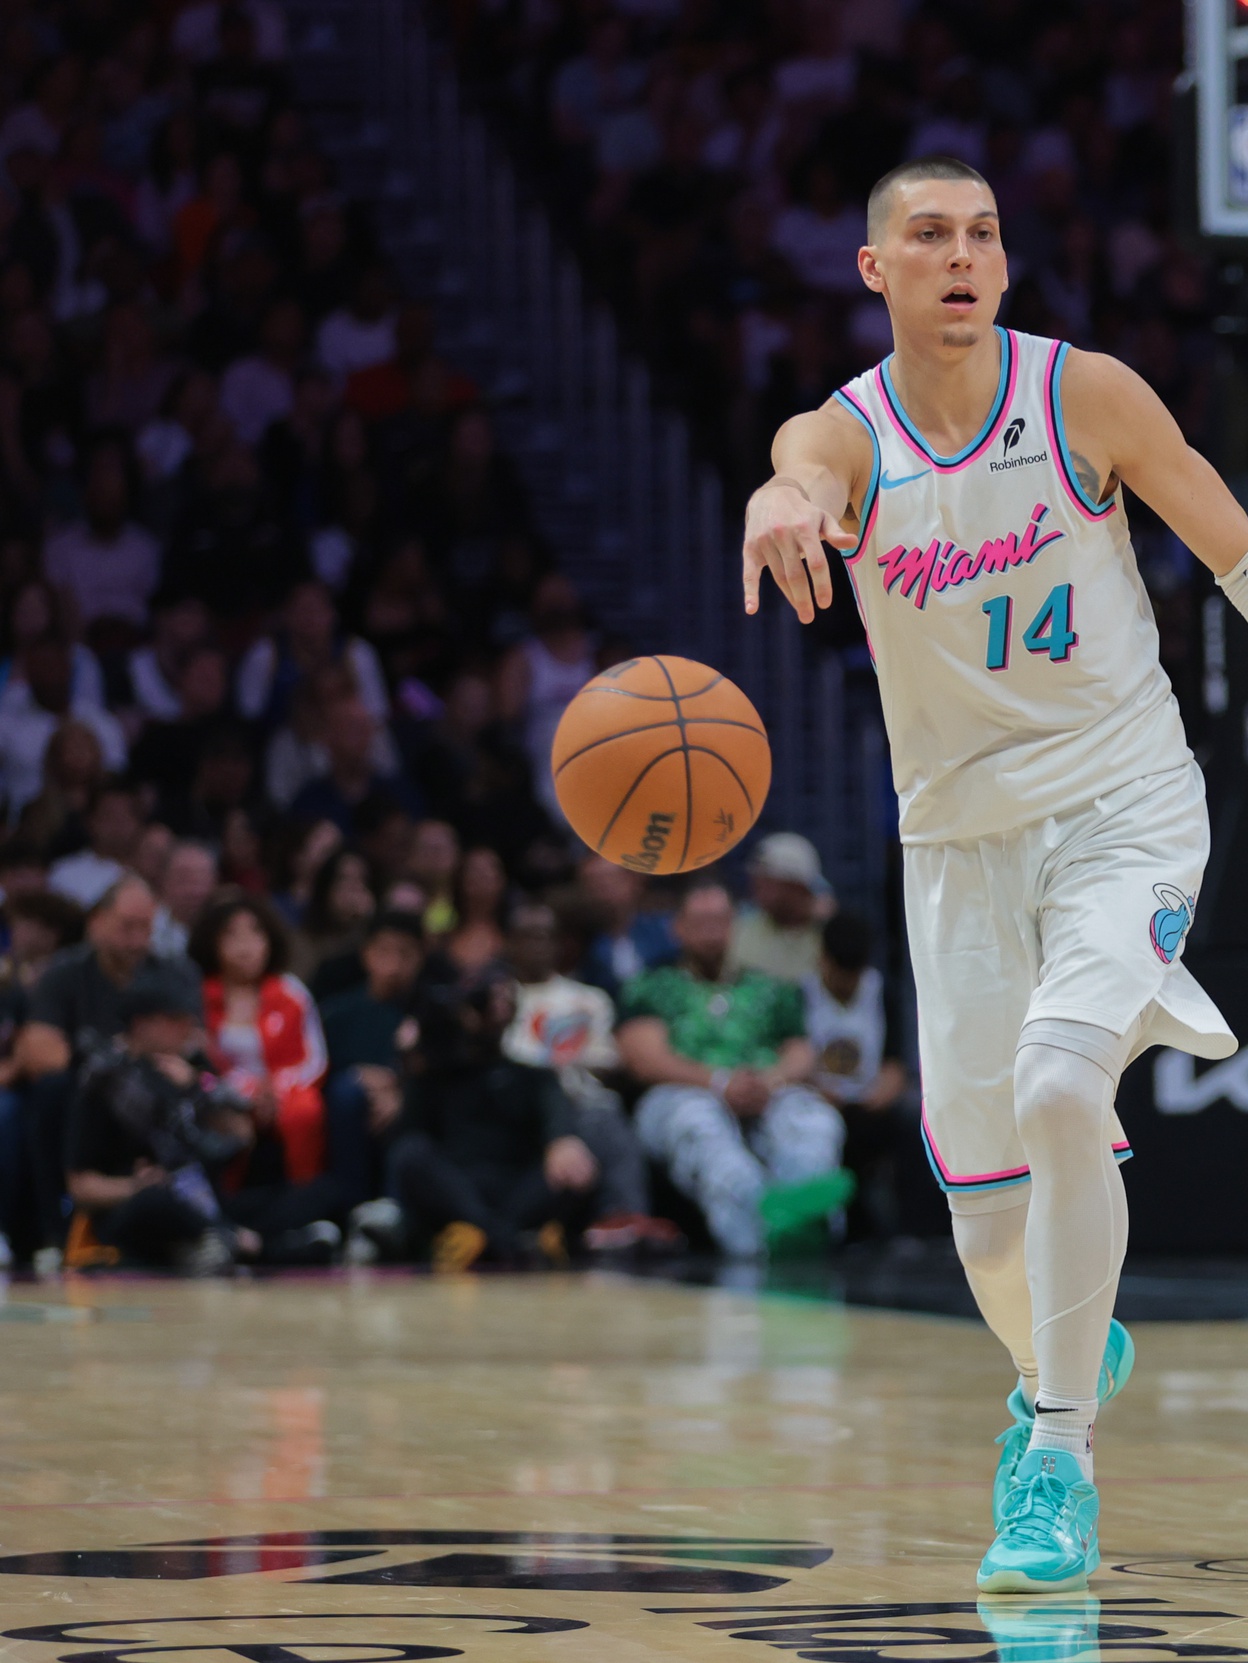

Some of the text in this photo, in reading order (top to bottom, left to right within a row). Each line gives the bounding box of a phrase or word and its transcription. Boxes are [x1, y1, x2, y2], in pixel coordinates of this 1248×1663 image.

[989, 450, 1048, 472] Robinhood
[877, 503, 1067, 611] Miami
[981, 583, 1079, 673] 14
